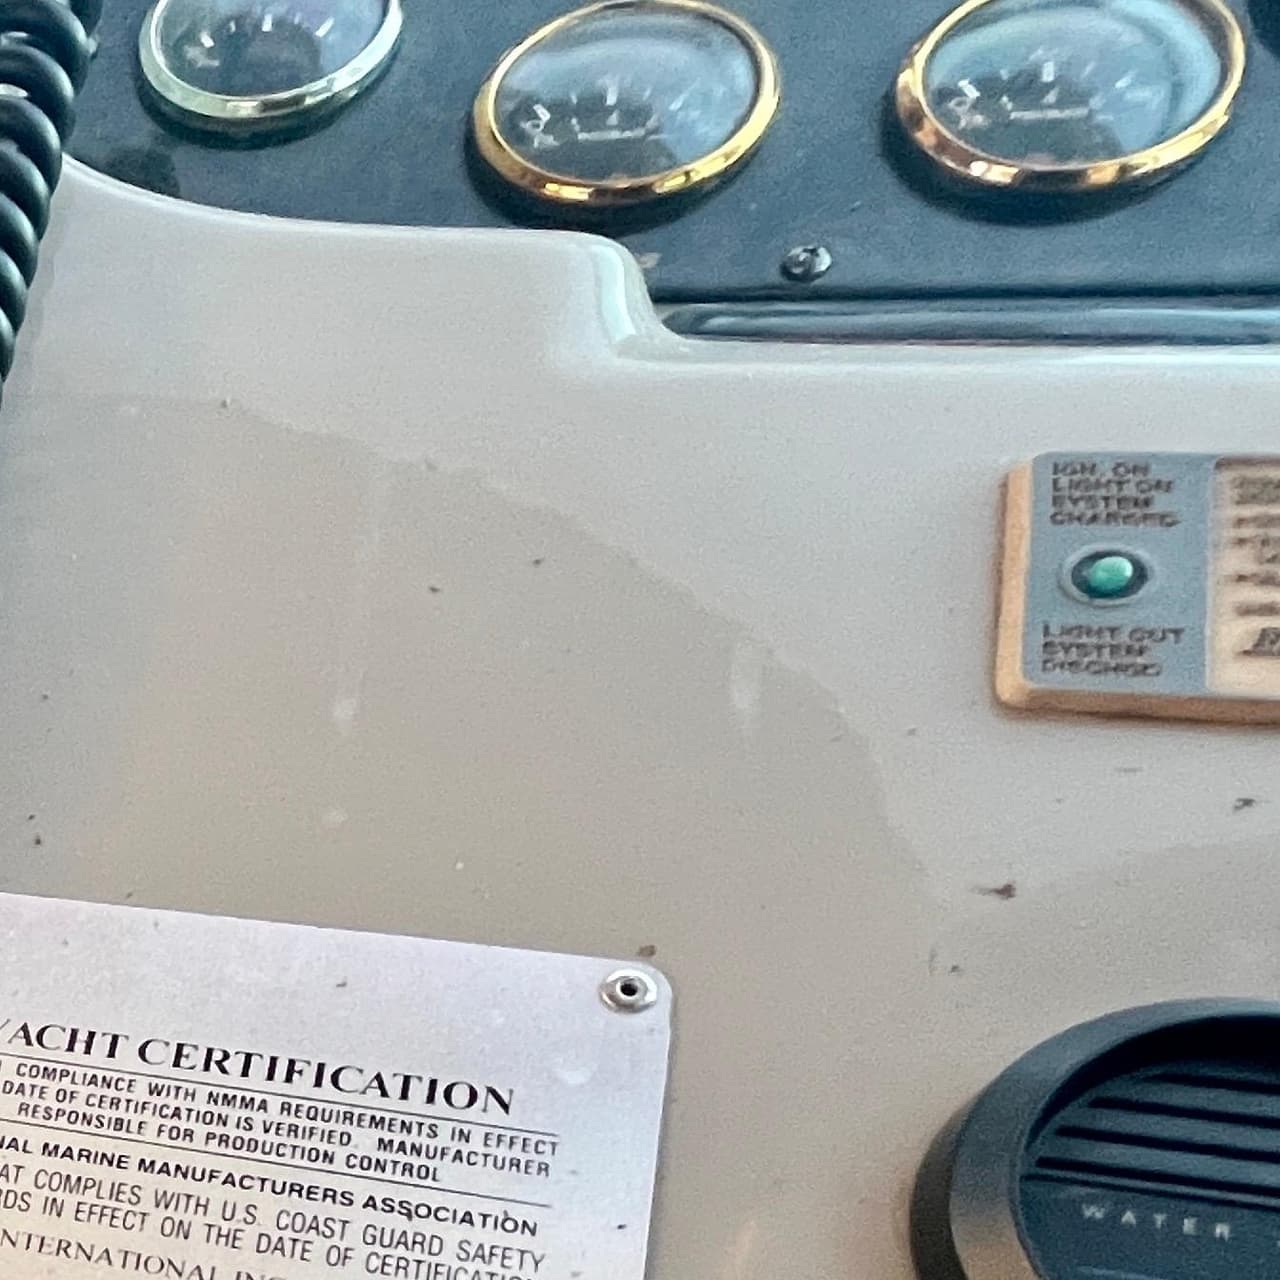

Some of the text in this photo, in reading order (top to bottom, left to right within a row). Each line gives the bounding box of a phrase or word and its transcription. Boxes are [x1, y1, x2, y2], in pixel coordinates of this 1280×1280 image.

[1136, 480, 1174, 493] ON
[1129, 628, 1185, 643] OUT
[16, 1063, 137, 1093] COMPLIANCE
[147, 1082, 196, 1102] WITH
[206, 1090, 268, 1114] NMMA
[280, 1101, 439, 1139] REQUIREMENTS
[450, 1126, 471, 1144] IN
[483, 1131, 560, 1157] EFFECT
[138, 1038, 514, 1115] CERTIFICATION
[2, 1080, 48, 1100] DATE
[55, 1088, 80, 1104] OF
[85, 1093, 229, 1128] CERTIFICATION
[236, 1115, 254, 1132] IS
[377, 1136, 551, 1178] MANUFACTURER
[18, 1102, 440, 1182] RESPONSIBLE FOR PRODUCTION CONTROL
[34, 1169, 142, 1206] COMPLIES
[154, 1189, 210, 1217] WITH
[221, 1200, 262, 1226] U.S.
[276, 1209, 351, 1241] COAST
[362, 1224, 443, 1257] GUARD
[456, 1240, 545, 1273] SAFETY
[41, 1142, 130, 1169] MARINE
[137, 1158, 354, 1207] MANUFACTURERS
[362, 1195, 538, 1237] ASSOCIATION
[1082, 1204, 1231, 1241] WATER
[42, 1196, 65, 1218] IN
[74, 1201, 151, 1233] EFFECT
[160, 1216, 192, 1240] ON
[204, 1223, 245, 1250] THE
[255, 1233, 314, 1263] DATE
[326, 1245, 355, 1268] OF
